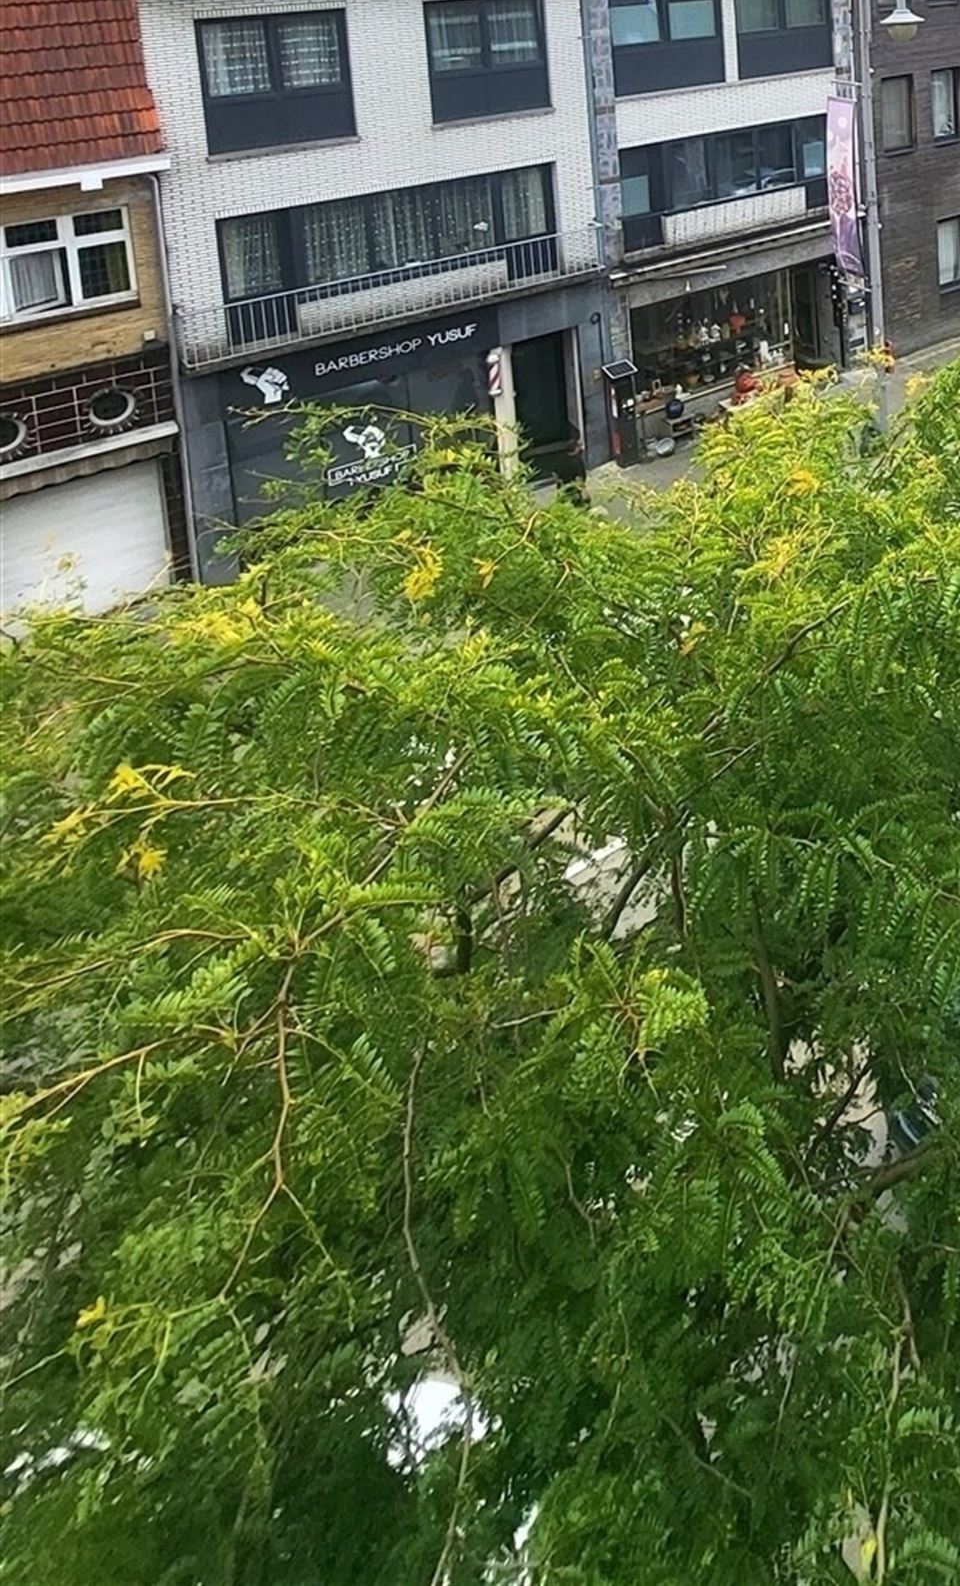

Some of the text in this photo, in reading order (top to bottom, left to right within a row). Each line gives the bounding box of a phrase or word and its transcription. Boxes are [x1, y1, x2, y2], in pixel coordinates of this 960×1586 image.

[314, 323, 477, 376] BARBERSHOP YUSUF
[334, 449, 411, 480] BARSHOP
[355, 464, 394, 483] YUSUF
